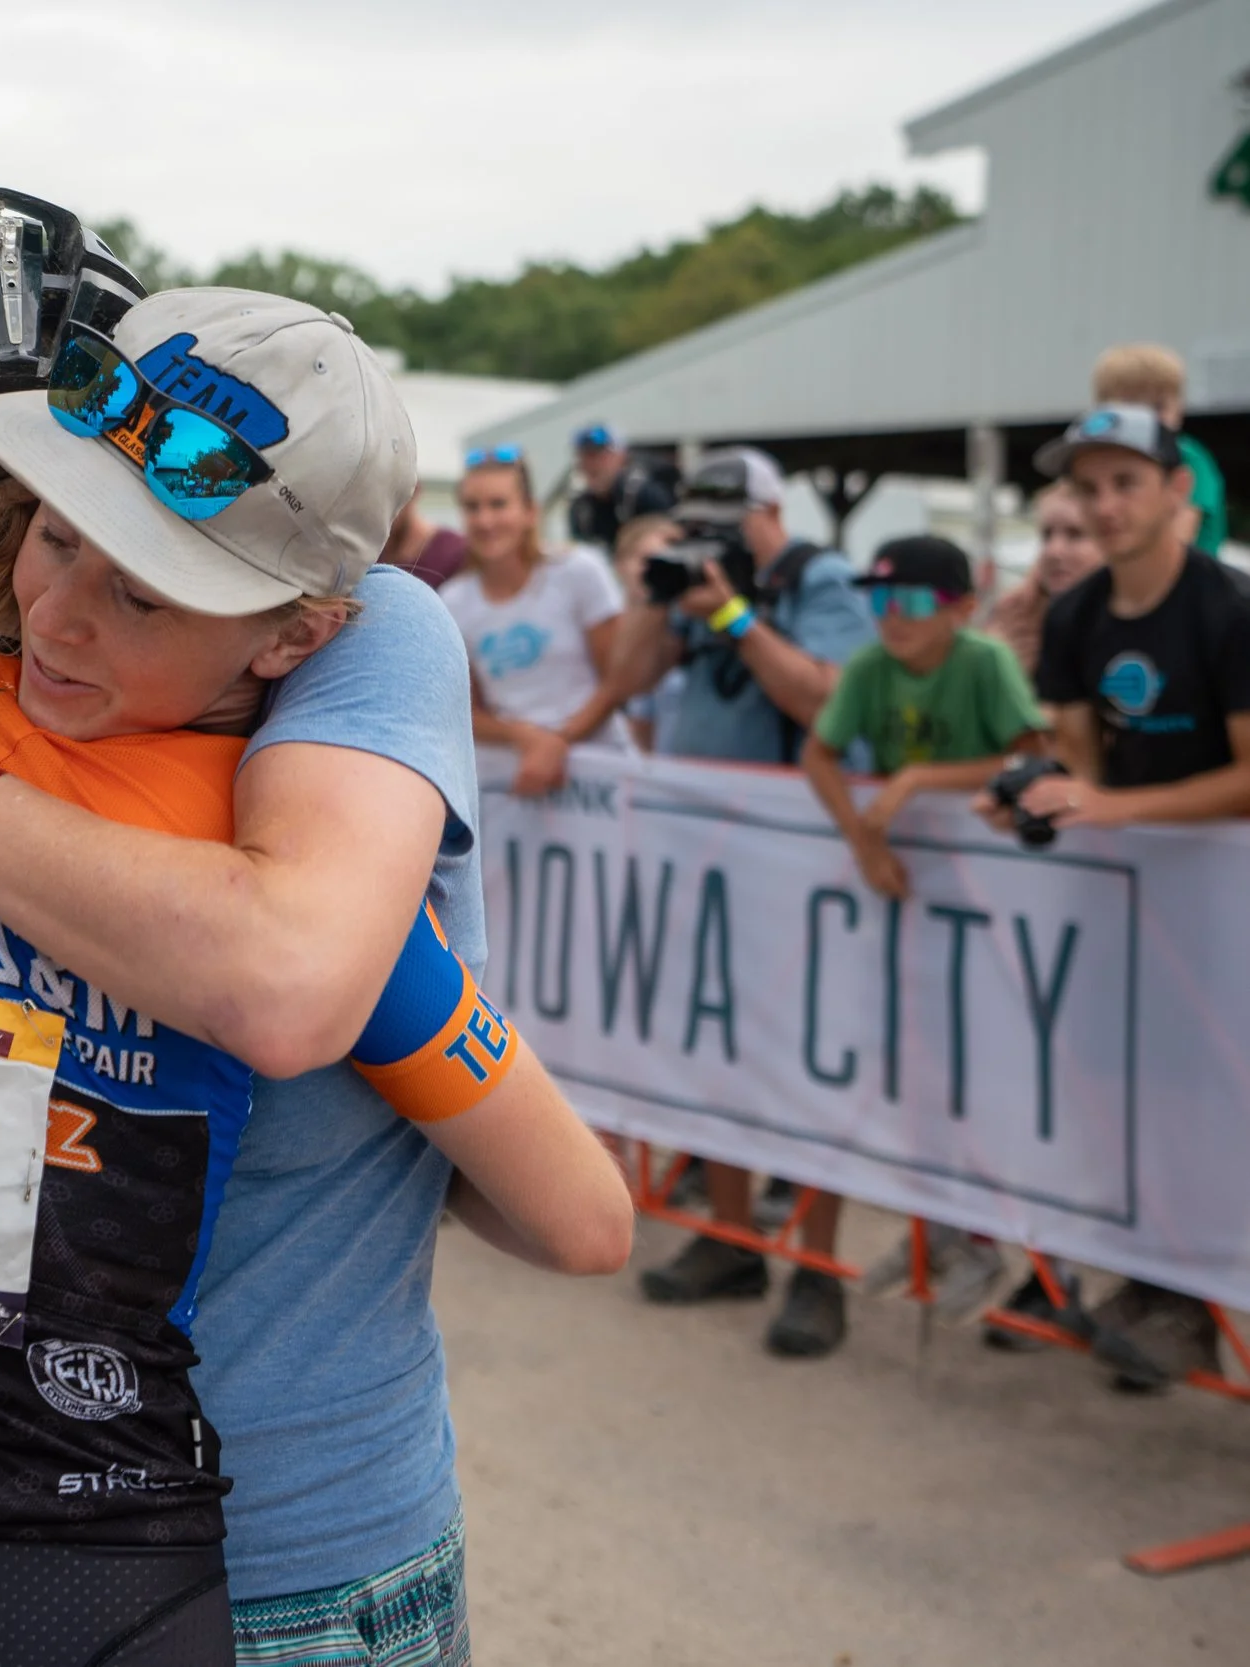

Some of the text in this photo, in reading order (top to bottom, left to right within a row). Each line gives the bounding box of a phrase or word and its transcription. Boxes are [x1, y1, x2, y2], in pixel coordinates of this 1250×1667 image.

[150, 354, 249, 429] TEAM
[506, 840, 1080, 1142] IOWA CITY
